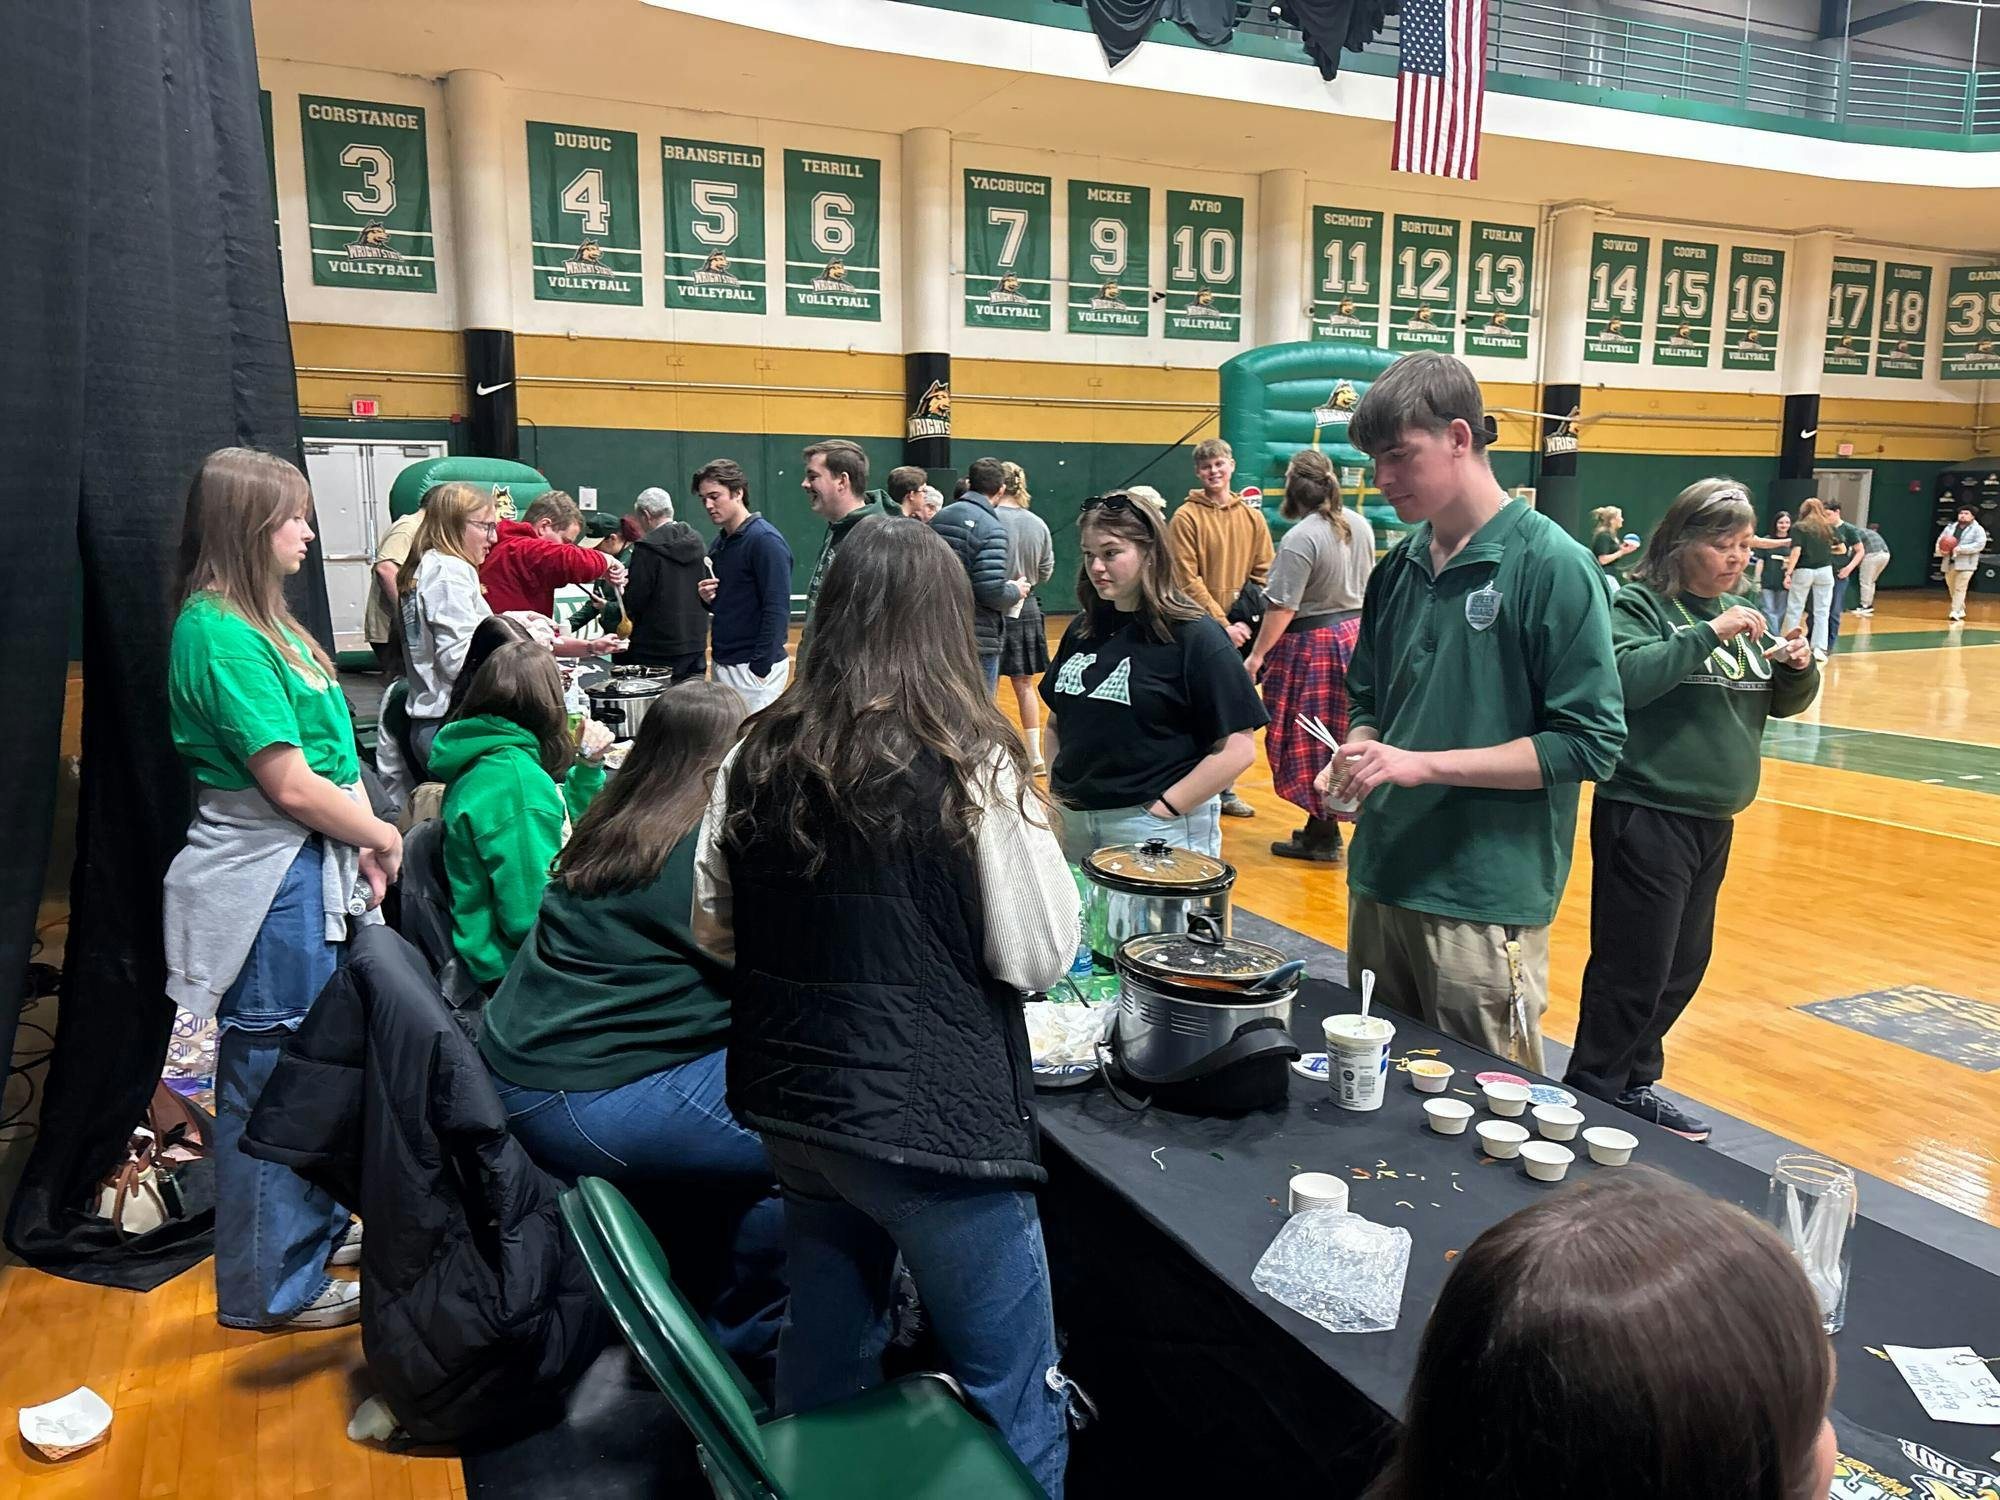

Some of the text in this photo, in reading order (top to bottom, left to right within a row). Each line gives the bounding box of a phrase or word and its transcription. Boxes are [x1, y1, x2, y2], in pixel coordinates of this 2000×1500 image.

[308, 104, 418, 130] CORSTANGE
[554, 131, 612, 152] DUBUC
[664, 145, 762, 168] BRANSFIELD
[802, 159, 863, 178] TERRILL
[339, 143, 397, 216] 3
[970, 176, 1045, 196] YACOBUCCI
[561, 168, 611, 235] 4
[1087, 188, 1132, 204] MCKEE
[691, 179, 738, 246] 5
[1189, 199, 1222, 214] AYRO
[811, 191, 855, 255] 6
[1324, 213, 1373, 228] SCHMIDT
[988, 206, 1028, 267] 7
[1482, 228, 1522, 243] FURLAN
[1089, 217, 1128, 275] 9
[1172, 225, 1235, 284] 10
[1673, 246, 1707, 259] COOPER
[328, 260, 423, 277] VOLLEYBALL
[1322, 239, 1370, 295] 11
[1397, 246, 1452, 301] 12
[548, 276, 631, 292] VOLLEYBALL
[1474, 252, 1525, 306] 13
[1591, 262, 1637, 314] 14
[678, 285, 756, 301] VOLLEYBALL
[797, 293, 871, 308] VOLLEYBALL
[1662, 269, 1709, 319] 15
[1730, 275, 1776, 323] 16
[975, 305, 1041, 319] VOLLEYBALL
[1828, 283, 1870, 329] 17
[1883, 289, 1925, 334] 18
[1078, 312, 1140, 325] VOLLEYBALL
[1173, 318, 1232, 330] VOLLEYBALL
[1318, 326, 1372, 339] VOLLEYBALL
[1396, 332, 1448, 344] VOLLEYBALL
[1472, 336, 1522, 348] VOLLEYBALL
[1588, 343, 1634, 354] VOLLEYBALL
[1659, 347, 1703, 358] VOLLEYBALL
[1728, 351, 1770, 361] VOLLEYBALL
